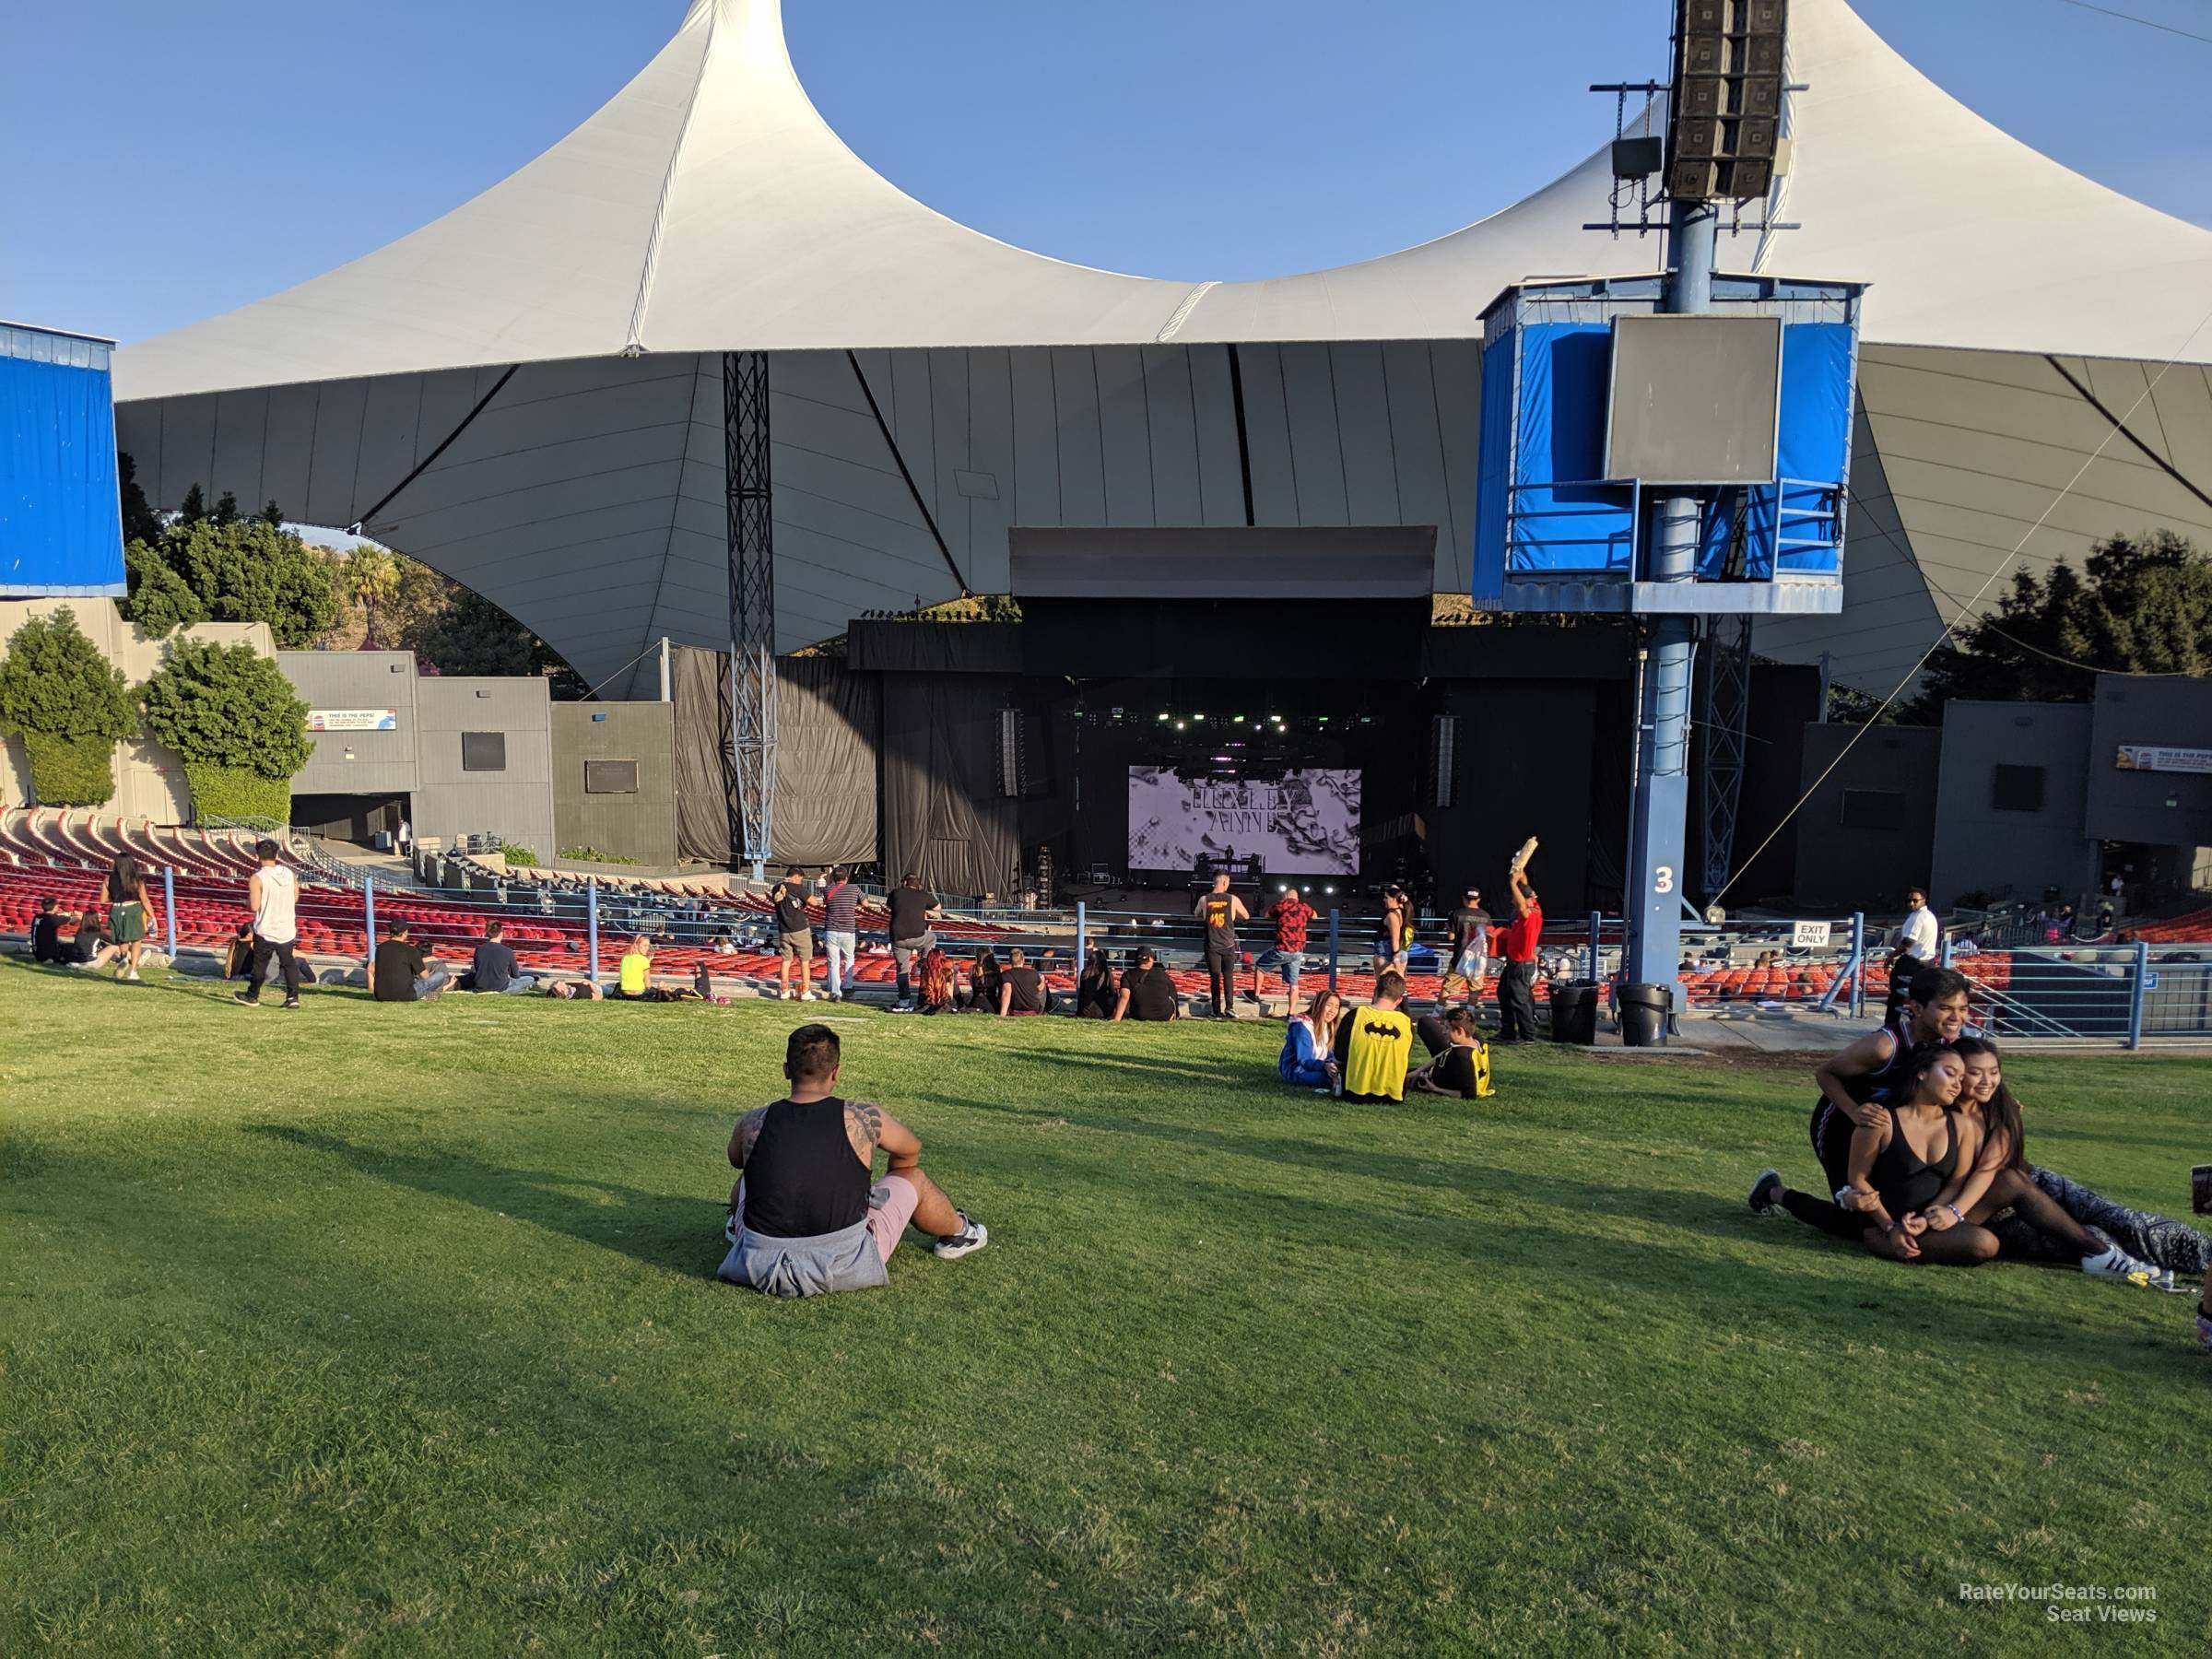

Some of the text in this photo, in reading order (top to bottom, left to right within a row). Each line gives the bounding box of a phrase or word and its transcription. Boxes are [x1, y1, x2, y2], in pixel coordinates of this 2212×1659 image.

[1209, 810, 1279, 833] ANNE
[1654, 865, 1674, 893] 3
[1800, 924, 1825, 934] EXIT
[1797, 935, 1827, 944] ONLY
